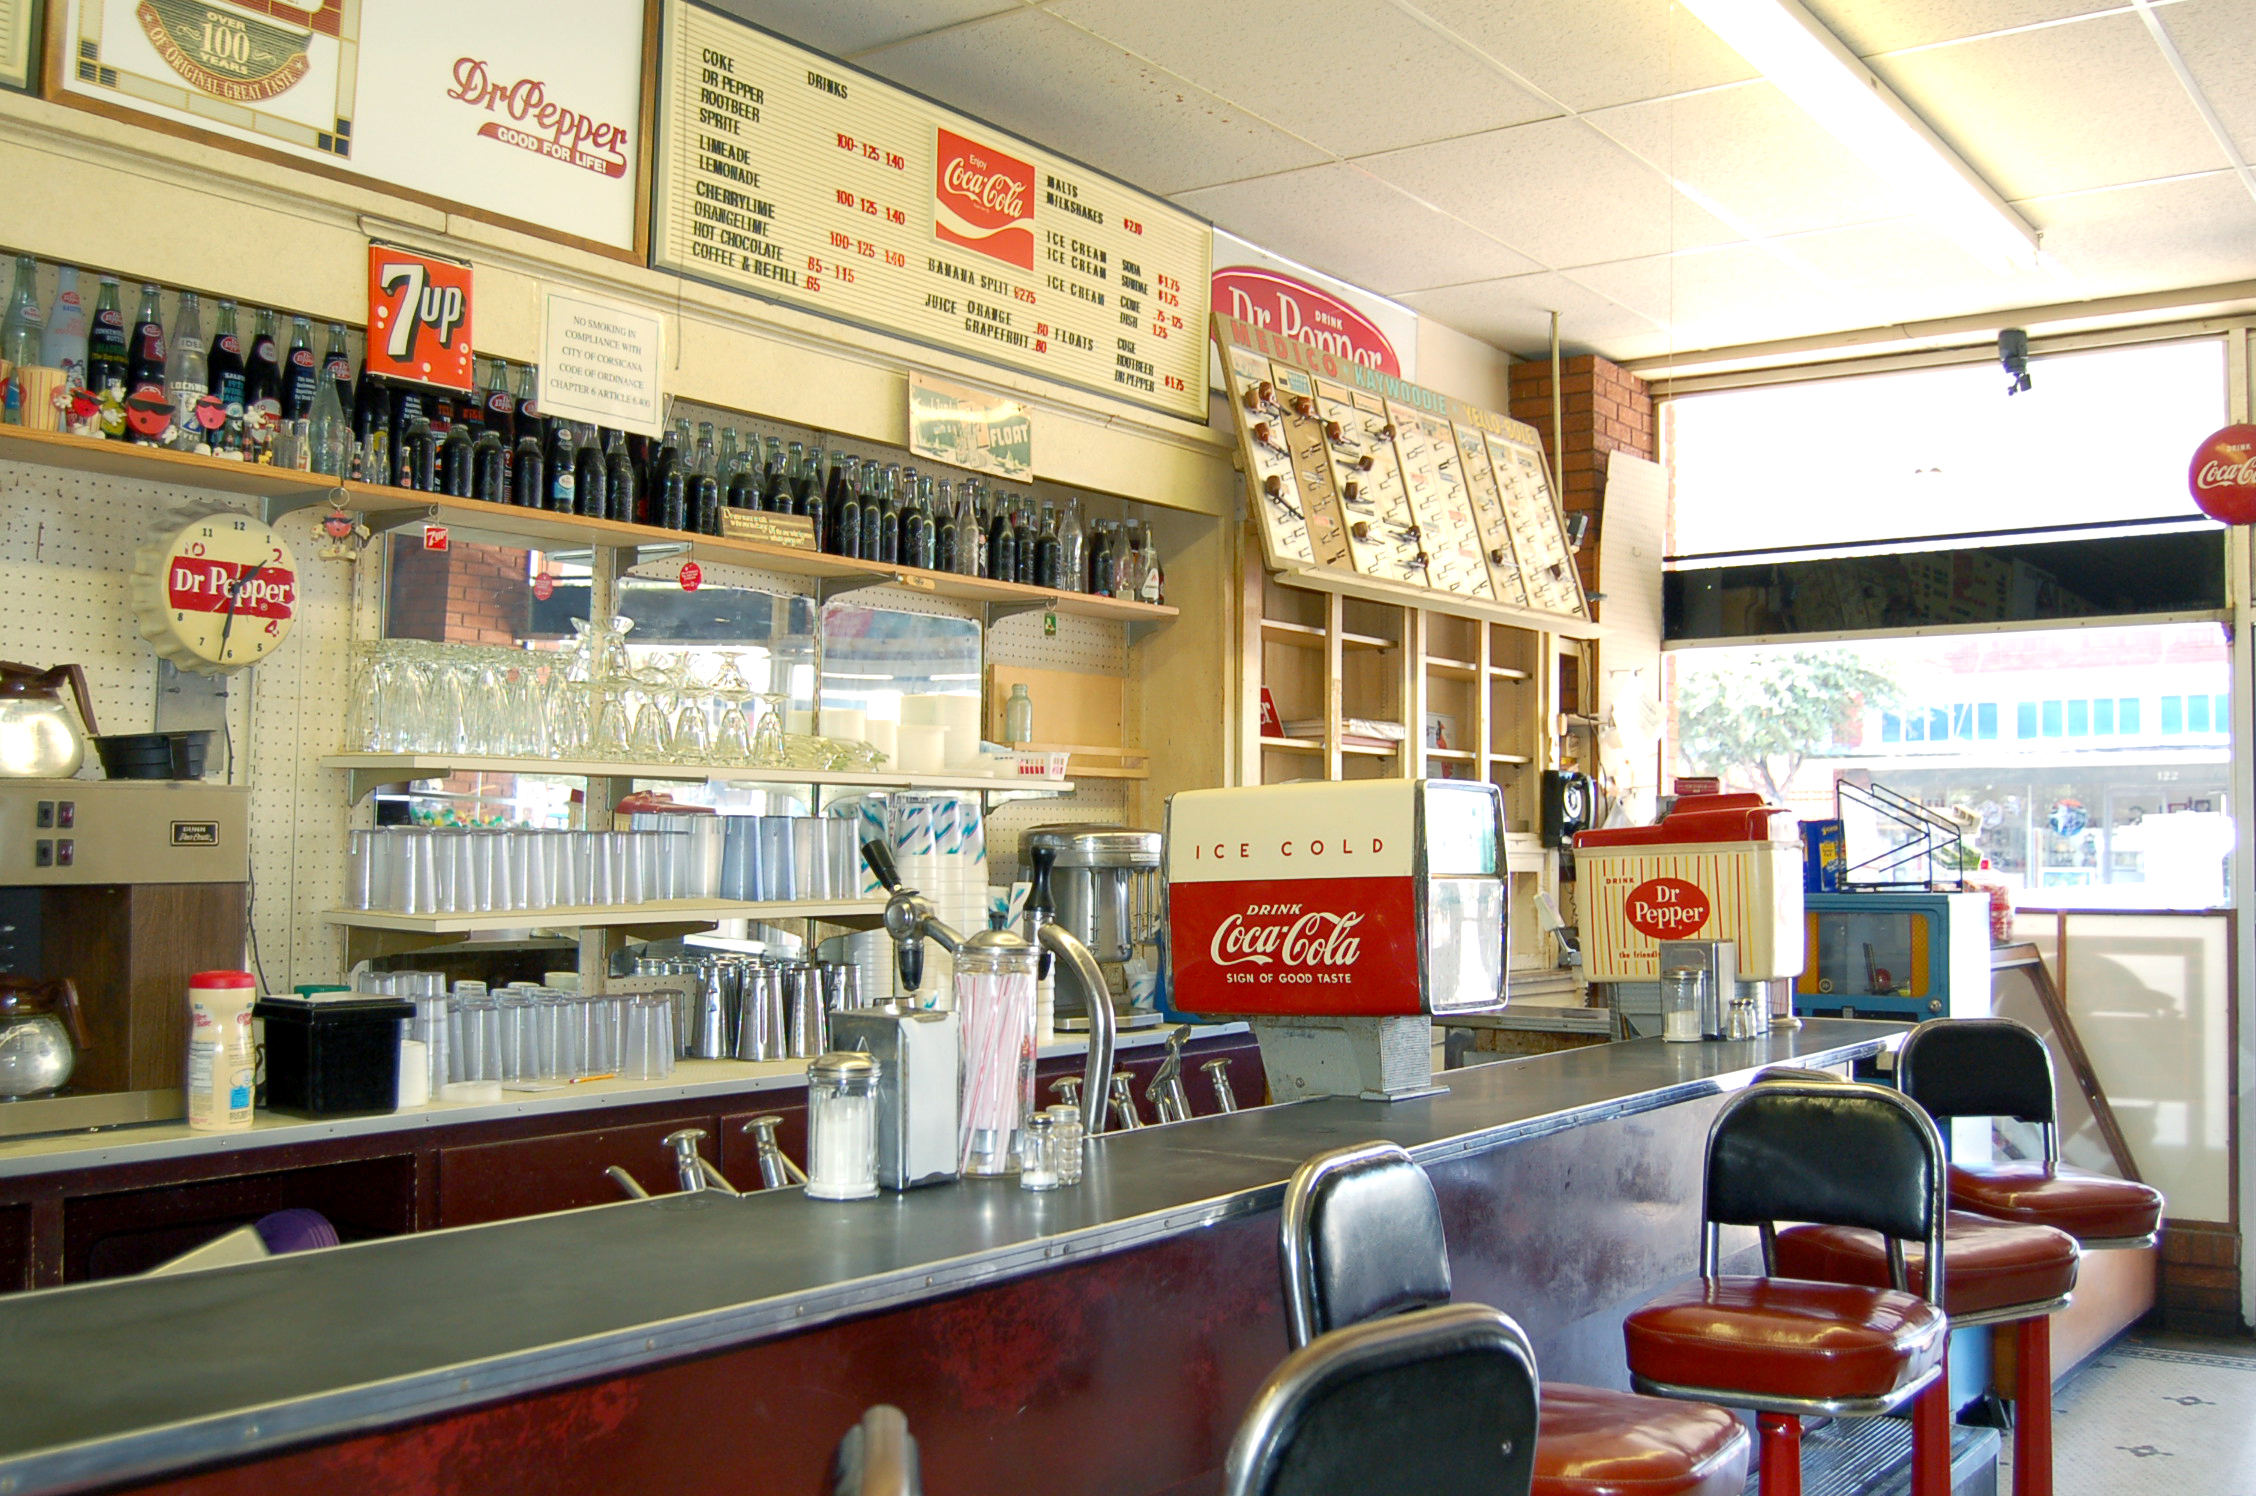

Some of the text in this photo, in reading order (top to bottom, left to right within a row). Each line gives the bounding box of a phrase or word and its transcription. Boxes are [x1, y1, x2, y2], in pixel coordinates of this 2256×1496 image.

[207, 12, 246, 31] OVER
[201, 23, 250, 64] 100
[149, 27, 297, 100] OF ORIGINAL GREAT TASTE
[201, 53, 248, 75] YEARS
[702, 48, 735, 74] COKE
[702, 68, 764, 105] DR PEPPER
[807, 70, 848, 100] DRINKS
[447, 57, 628, 153] Dr Pepper
[700, 87, 760, 123] ROOTBEER
[700, 107, 740, 136] SPRITE
[498, 127, 607, 174] GOOD FOR LIFE!
[700, 134, 751, 166] LIMEADE
[863, 143, 880, 161] 125
[970, 154, 988, 170] Enjoy
[699, 154, 760, 188] LEMONADE
[944, 157, 1027, 218] Coca-Cola
[1047, 174, 1078, 198] MALTS
[696, 180, 776, 220] CHERRYLIME
[836, 189, 854, 208] 100
[861, 198, 878, 216] 125
[1046, 190, 1104, 225] MILKSHAKES
[694, 201, 770, 238] ORANGELIME
[694, 220, 784, 262] HOT CHOCOLATE
[858, 240, 876, 258] 125
[1046, 230, 1142, 278] ICE CREAM SODA
[692, 240, 736, 268] COFFEE
[742, 256, 750, 272] &
[754, 258, 799, 287] REFILL
[836, 264, 855, 284] 115
[1046, 246, 1066, 265] ICE
[1071, 256, 1107, 280] CREAM
[1121, 274, 1149, 296] SUNDAE
[928, 258, 975, 286] BANANA
[980, 274, 1008, 296] SPLIT
[1046, 274, 1141, 314] ICE CREAM CONE
[925, 293, 957, 315] JUICE
[967, 300, 1012, 326] ORANGE
[1120, 311, 1138, 329] DISH
[1228, 286, 1271, 329] Dr
[1315, 310, 1343, 330] DRINK
[573, 316, 636, 338] NO SMOKING IN
[964, 318, 1030, 348] GRAPEFRUIT
[565, 329, 642, 355] COMPLIANCE WITH
[1054, 328, 1137, 354] FLOATS COKE
[1230, 319, 1338, 377] MEDICO
[562, 346, 643, 372] CITY OF CORSICANA
[1116, 353, 1155, 377] ROOTBEER
[559, 362, 644, 390] CODE OF ORDINANCE
[1126, 372, 1155, 393] PEPPER
[550, 378, 590, 394] CHAPTER
[591, 388, 596, 396] 6
[598, 389, 631, 404] ARTICLE
[1353, 363, 1447, 417] KAYWOODIE
[989, 424, 1029, 448] FLOAT
[2226, 443, 2252, 453] DRINK
[202, 527, 214, 538] 11
[234, 521, 246, 532] 12
[266, 535, 272, 544] 1
[184, 542, 207, 558] 10
[272, 548, 284, 565] 2
[174, 566, 290, 608] Dr Pepper
[177, 612, 184, 622] 8
[264, 620, 280, 638] 4
[199, 637, 206, 646] 7
[227, 649, 234, 660] 6
[256, 643, 264, 652] 5
[2158, 770, 2179, 781] 122
[1195, 838, 1384, 860] ICE COLD
[1606, 877, 1635, 885] DRINK
[1656, 885, 1680, 903] Dr
[1246, 903, 1304, 916] DRINK
[1634, 901, 1704, 930] Pepper
[1210, 910, 1366, 967] Coca-Cola
[1618, 951, 1631, 959] the
[1226, 972, 1352, 984] SIGN OF GOOD TASTE
